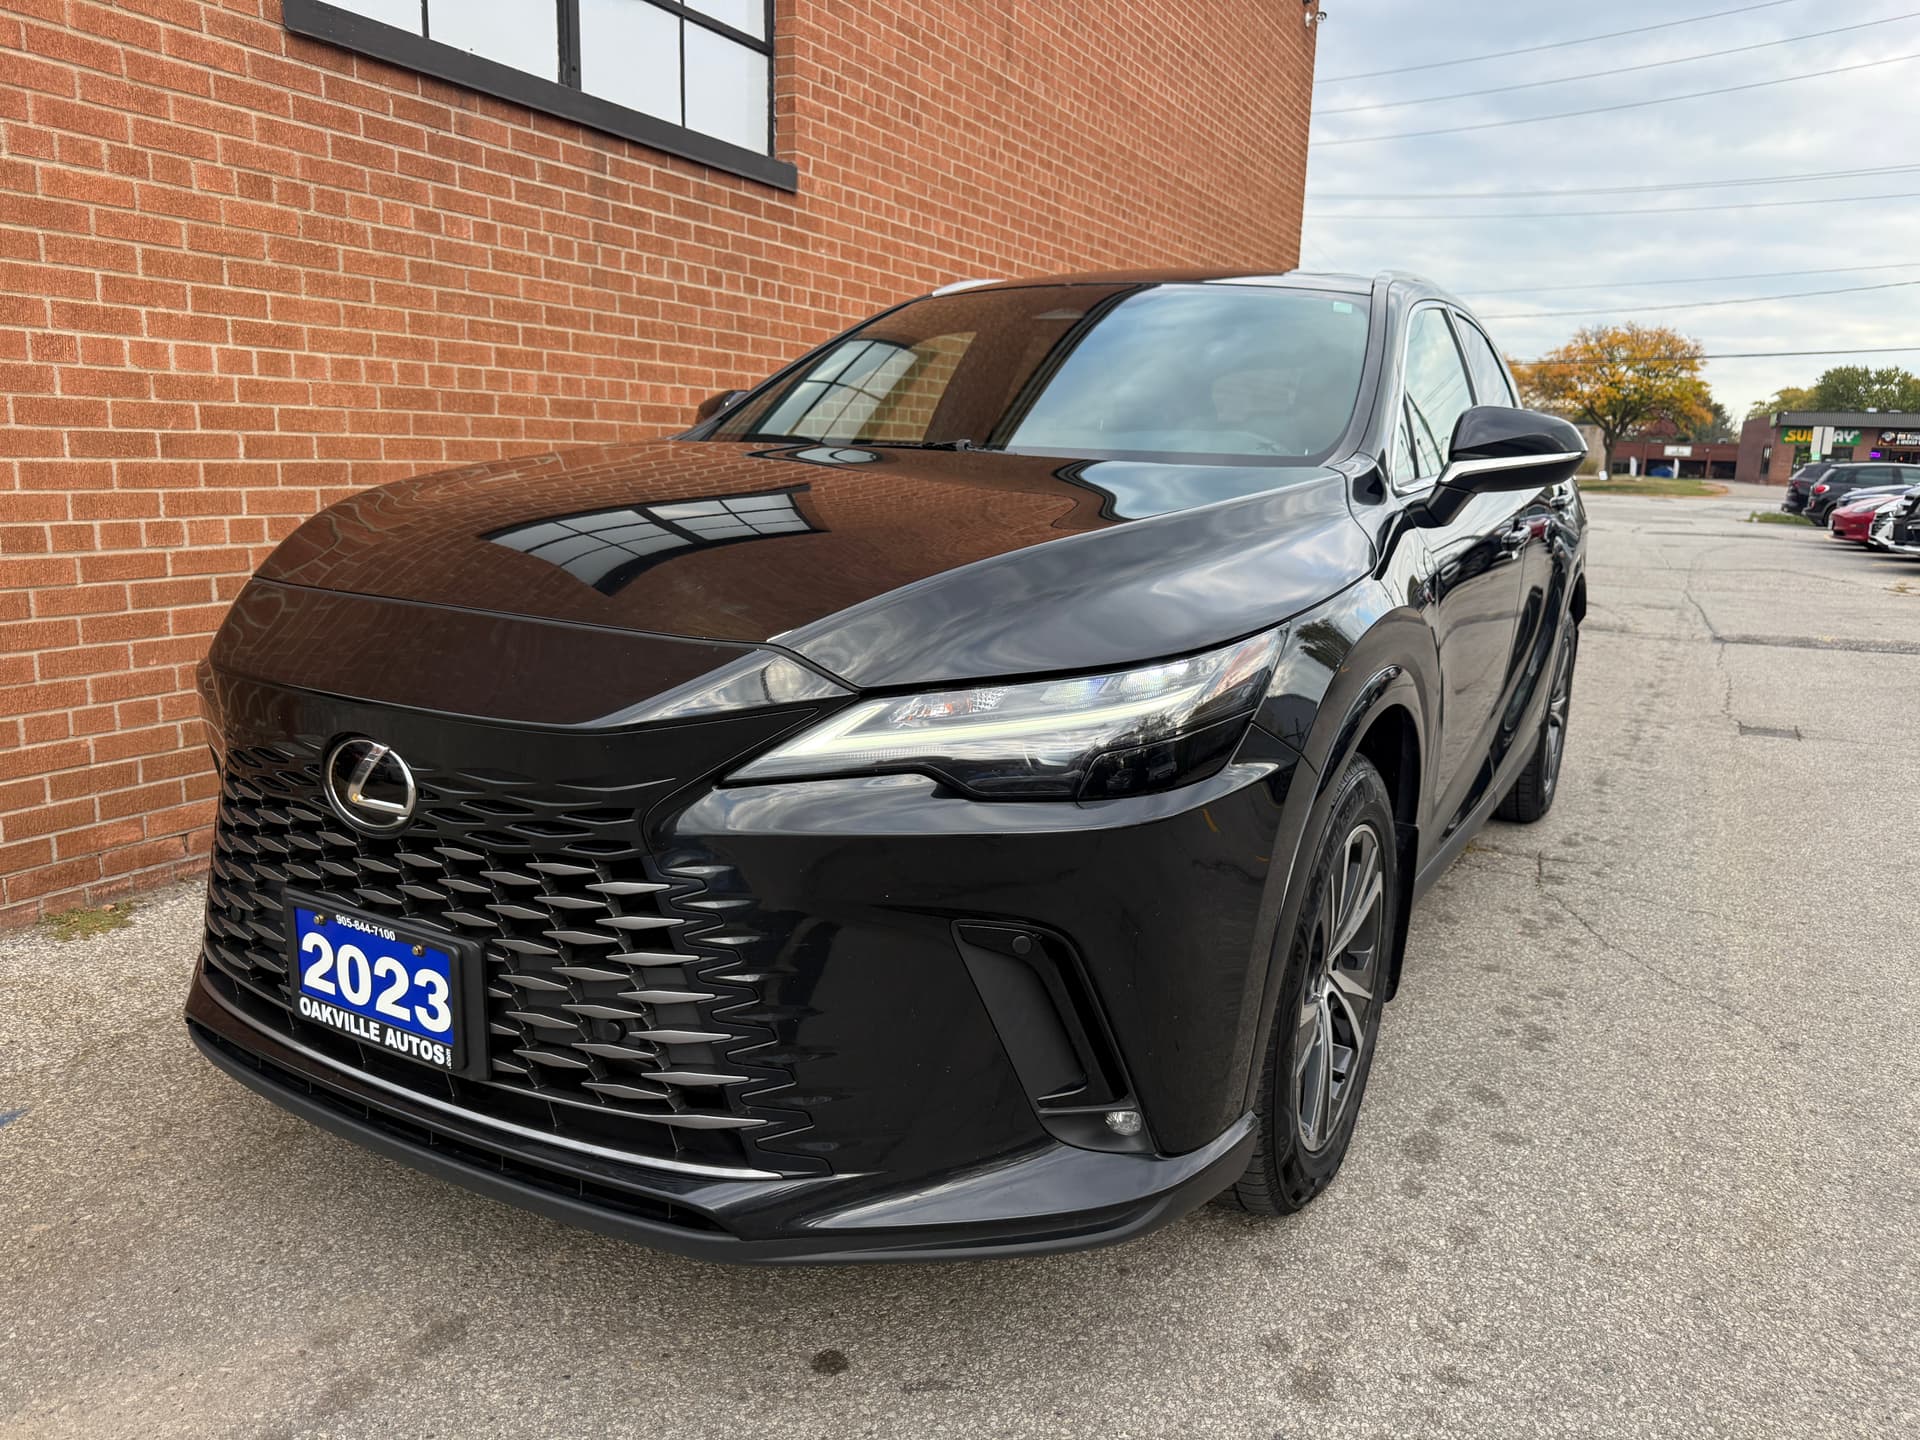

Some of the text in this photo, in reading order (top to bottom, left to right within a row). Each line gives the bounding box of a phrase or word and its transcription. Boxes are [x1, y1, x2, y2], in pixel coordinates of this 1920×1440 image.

[1784, 430, 1859, 442] SUAY
[336, 914, 396, 941] 905-844-7100
[301, 932, 452, 1033] 2023
[299, 997, 445, 1065] OAKVILLE AUTOS
